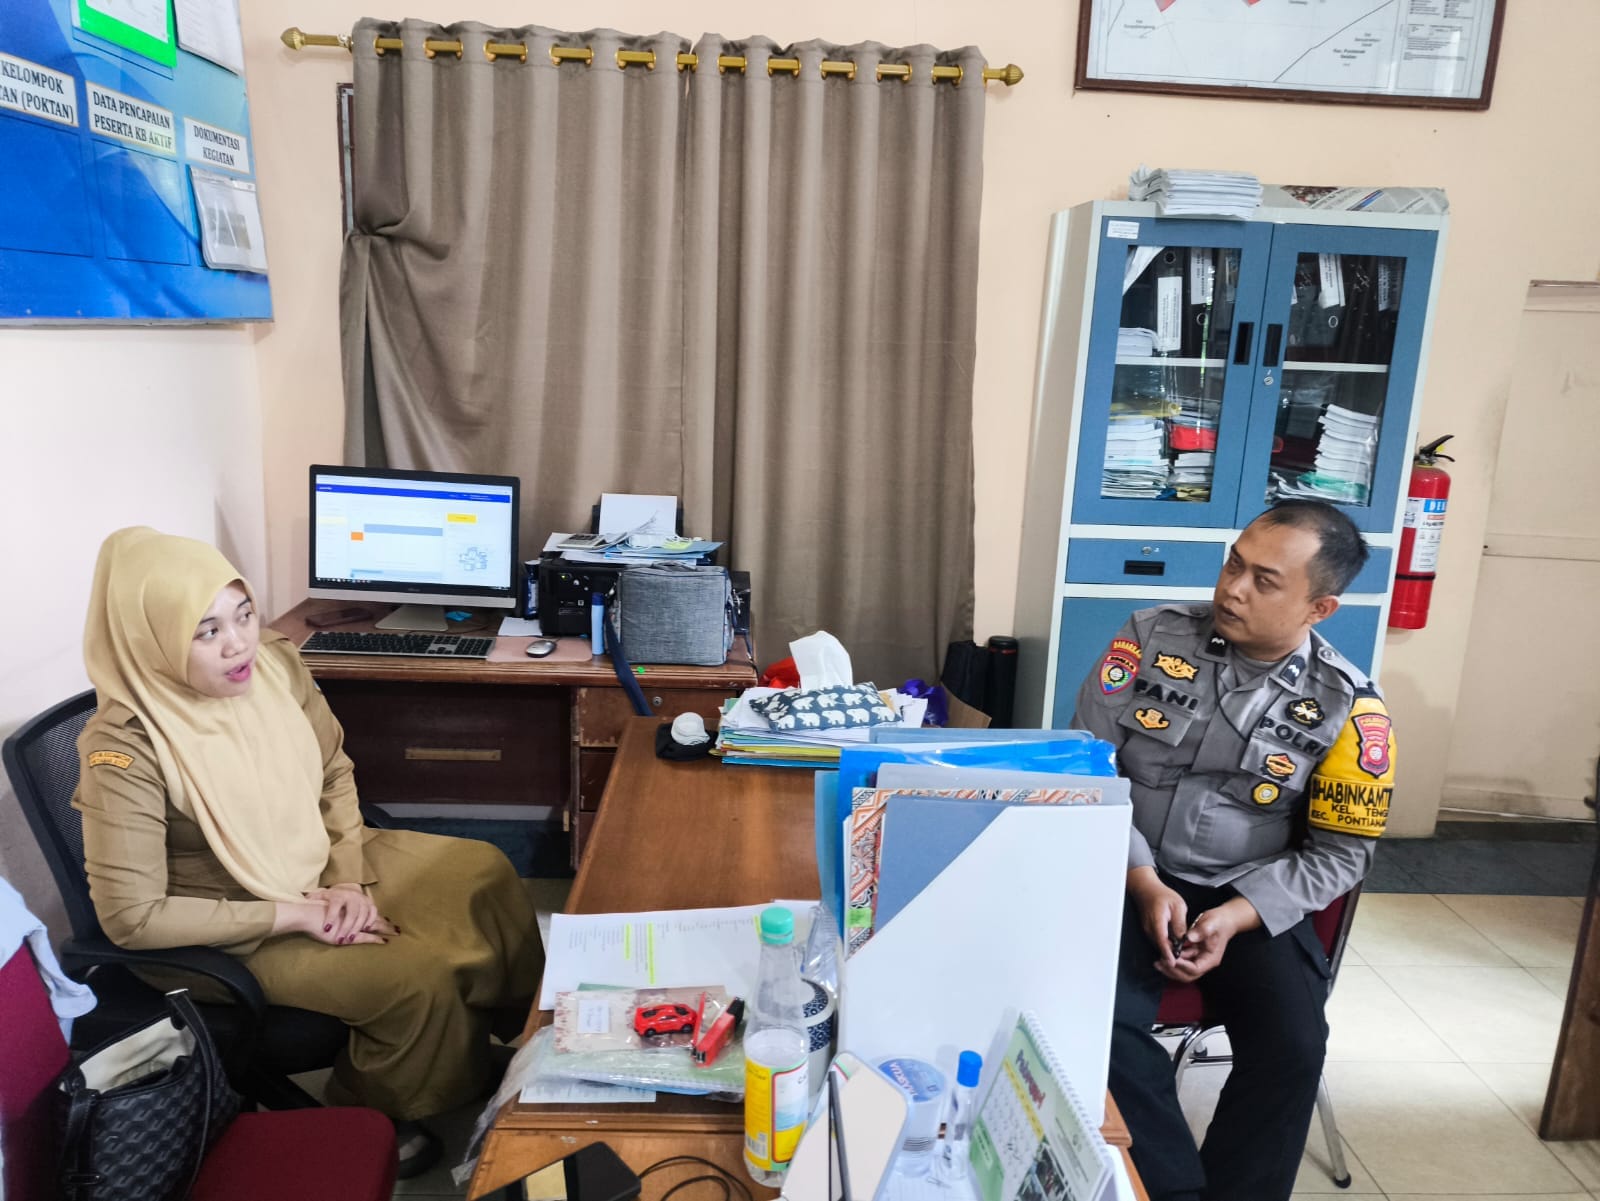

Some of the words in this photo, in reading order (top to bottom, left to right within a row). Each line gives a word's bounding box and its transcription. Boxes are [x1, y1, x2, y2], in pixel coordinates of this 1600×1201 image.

[1, 60, 64, 95] KELOMPOK
[21, 90, 74, 124] (POKTAN)
[93, 91, 117, 112] DATA
[118, 99, 171, 129] PENCAPAIAN
[94, 113, 133, 138] PESERTA
[134, 126, 147, 142] KB
[148, 131, 172, 149] AKTIF
[193, 125, 240, 151] DOKUMENTASI
[202, 146, 235, 166] KEGIATAN
[1260, 716, 1328, 756] POLRI
[1331, 803, 1355, 815] KEL.
